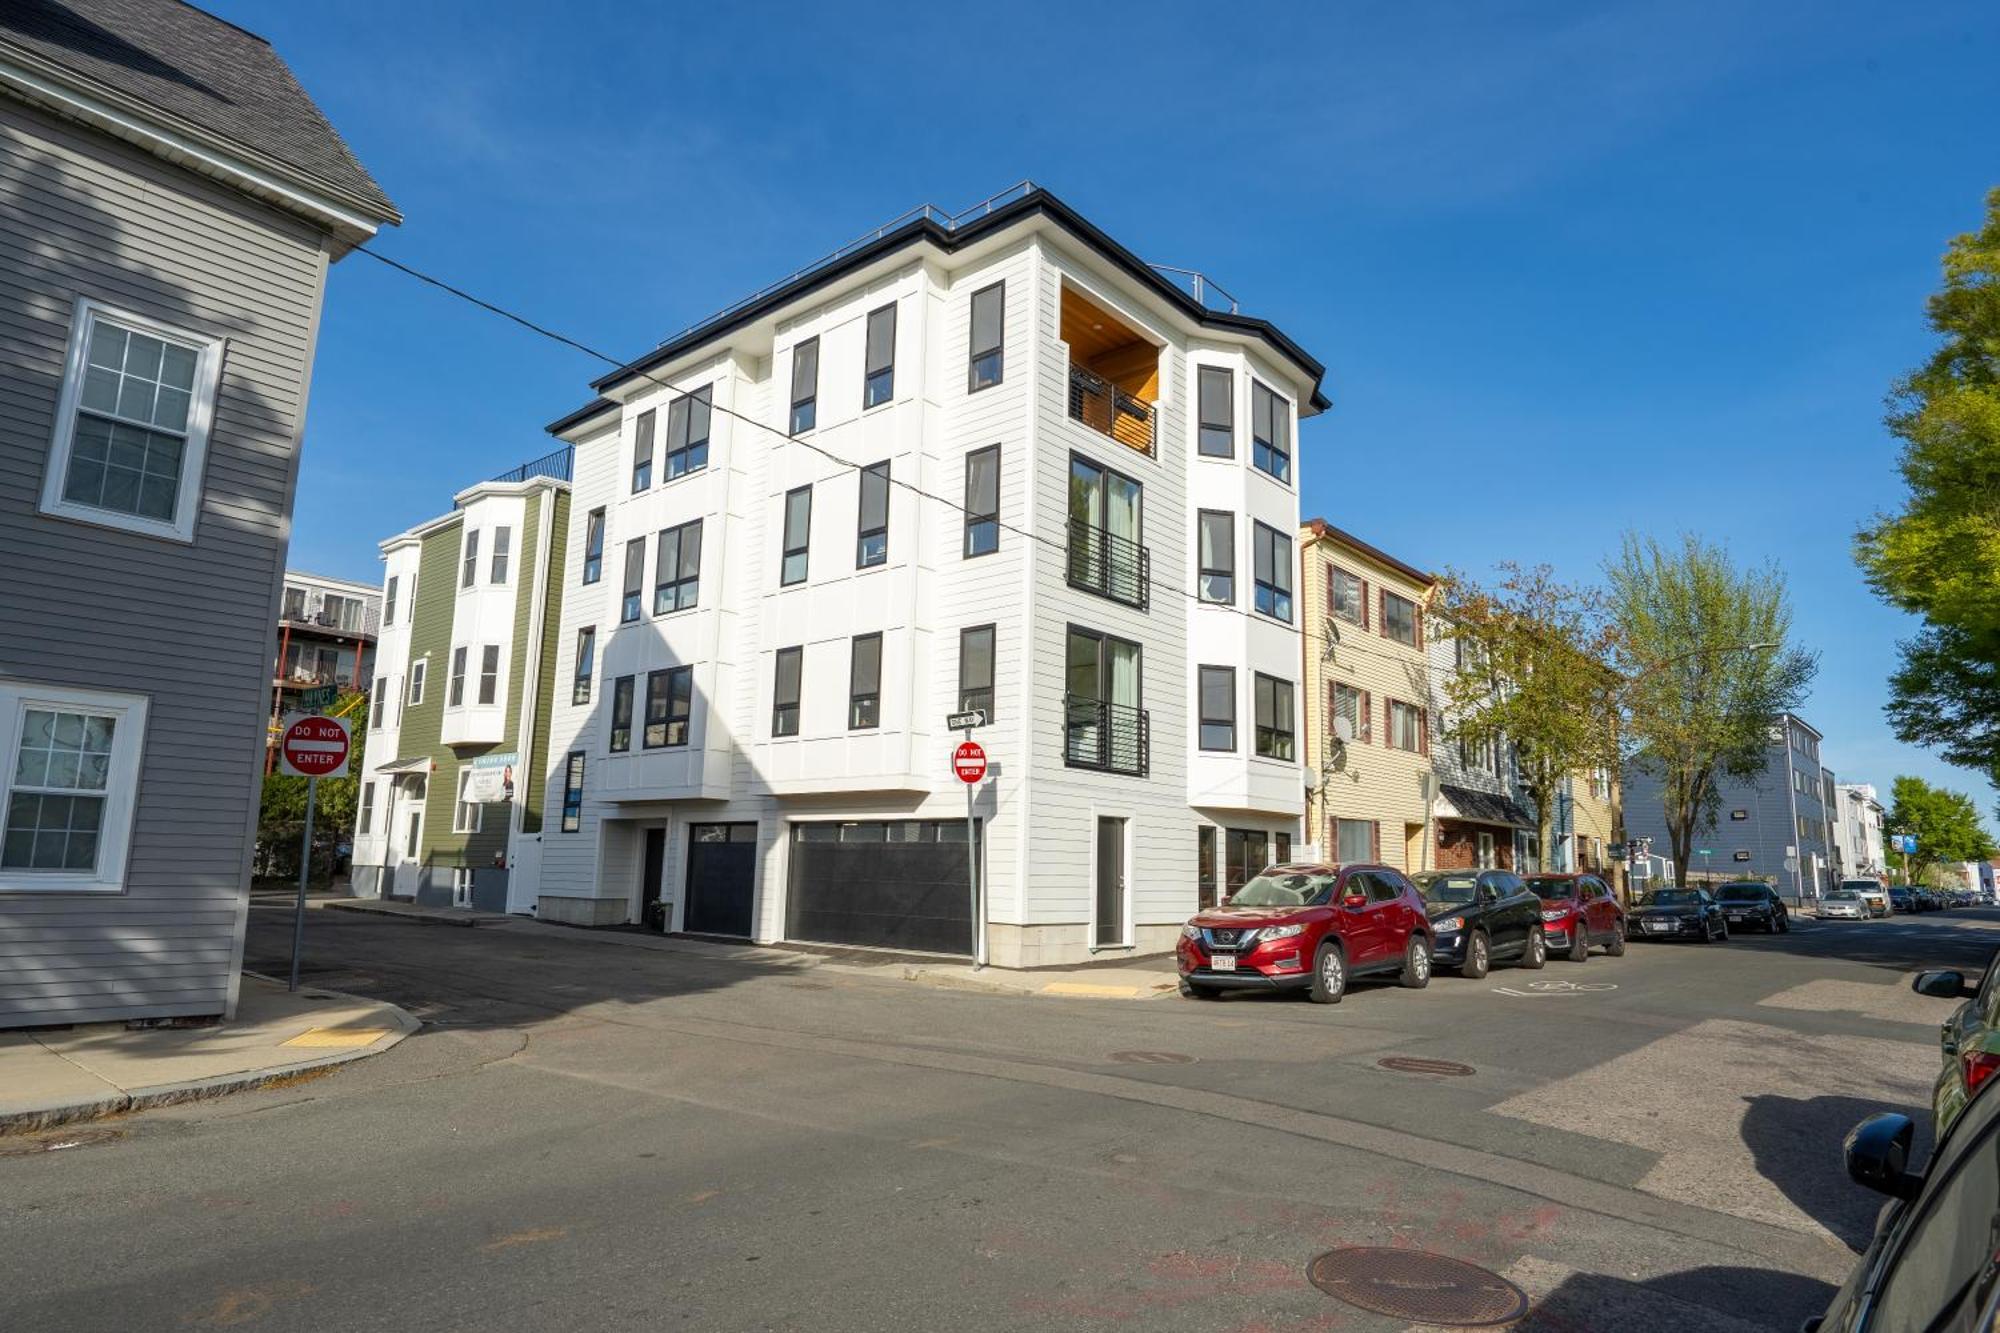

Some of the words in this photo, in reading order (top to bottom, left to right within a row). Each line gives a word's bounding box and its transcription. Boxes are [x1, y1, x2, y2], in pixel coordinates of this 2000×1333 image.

[295, 726, 311, 736] DO
[319, 728, 341, 738] NOT
[297, 753, 334, 764] ENTER
[959, 749, 967, 757] DO
[971, 749, 982, 757] NOT
